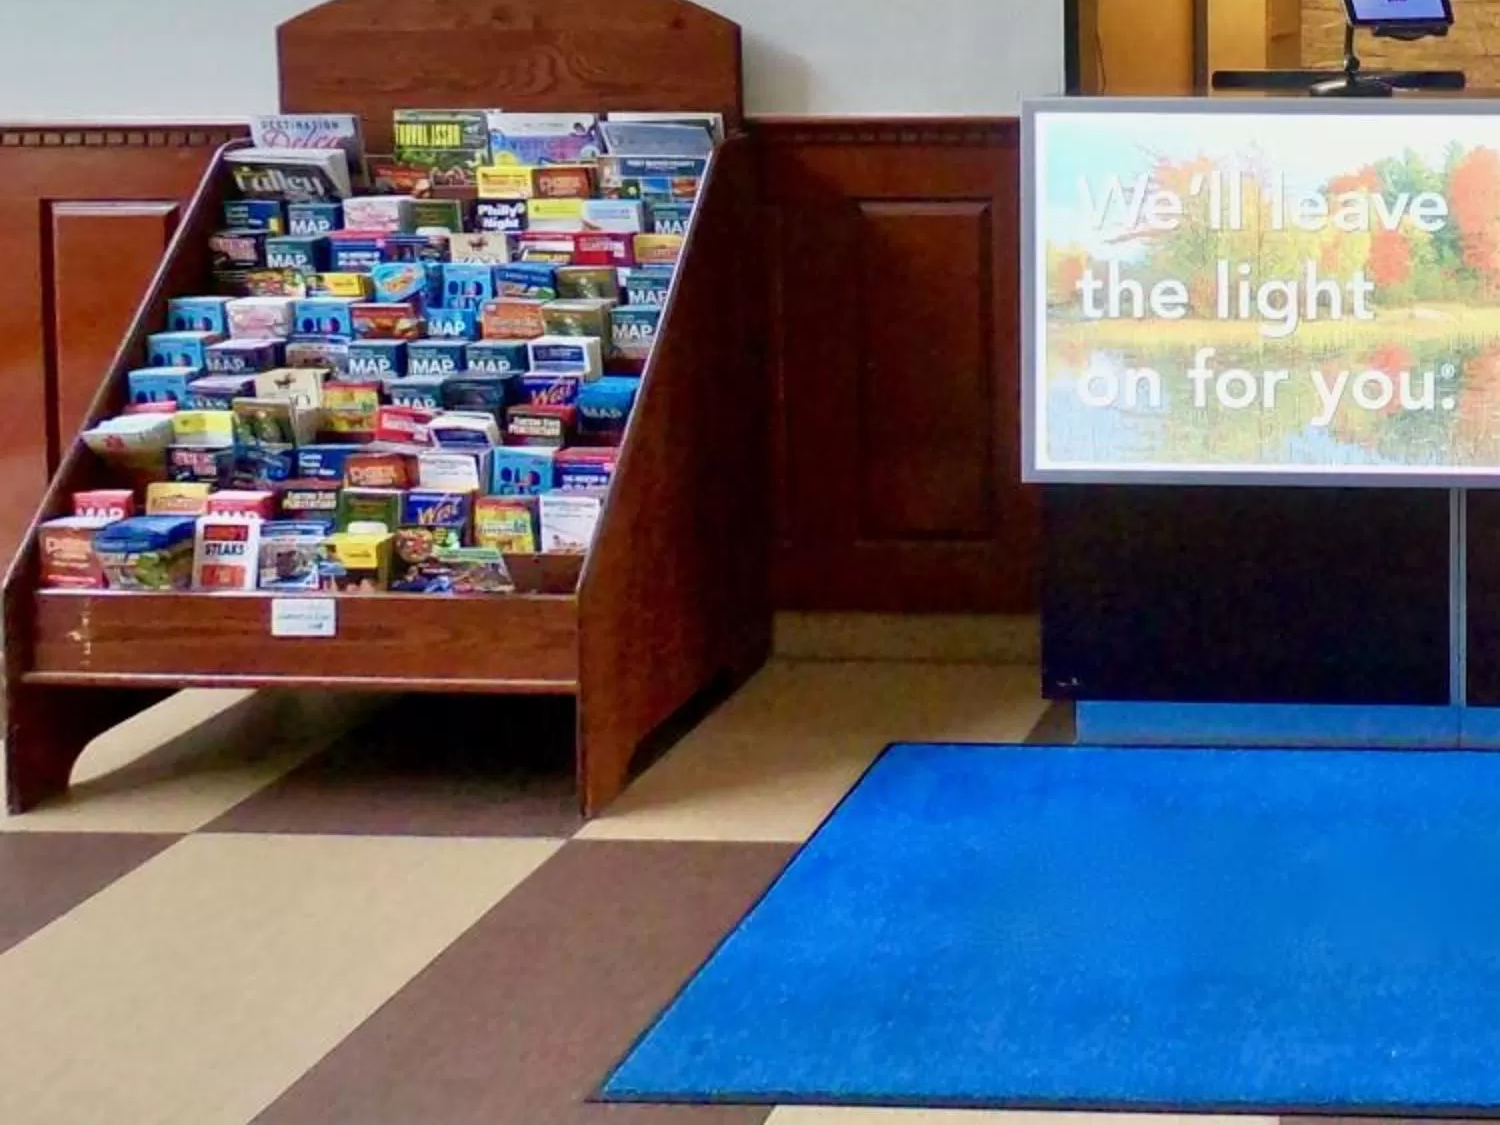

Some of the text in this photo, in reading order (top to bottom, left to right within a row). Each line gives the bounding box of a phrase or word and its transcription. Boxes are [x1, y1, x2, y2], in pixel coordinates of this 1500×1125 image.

[1079, 171, 1449, 232] We'll leave
[290, 219, 330, 236] MAP
[267, 254, 308, 269] MAP
[1076, 259, 1376, 338] the light
[427, 319, 466, 336] MAP
[612, 324, 653, 341] MAP
[351, 358, 391, 375] MAP
[411, 358, 455, 375] MAP
[469, 359, 511, 374] MAP
[1077, 364, 1162, 409] on
[1187, 346, 1290, 410] for
[75, 506, 125, 520] MAP
[205, 543, 245, 556] STEAKS
